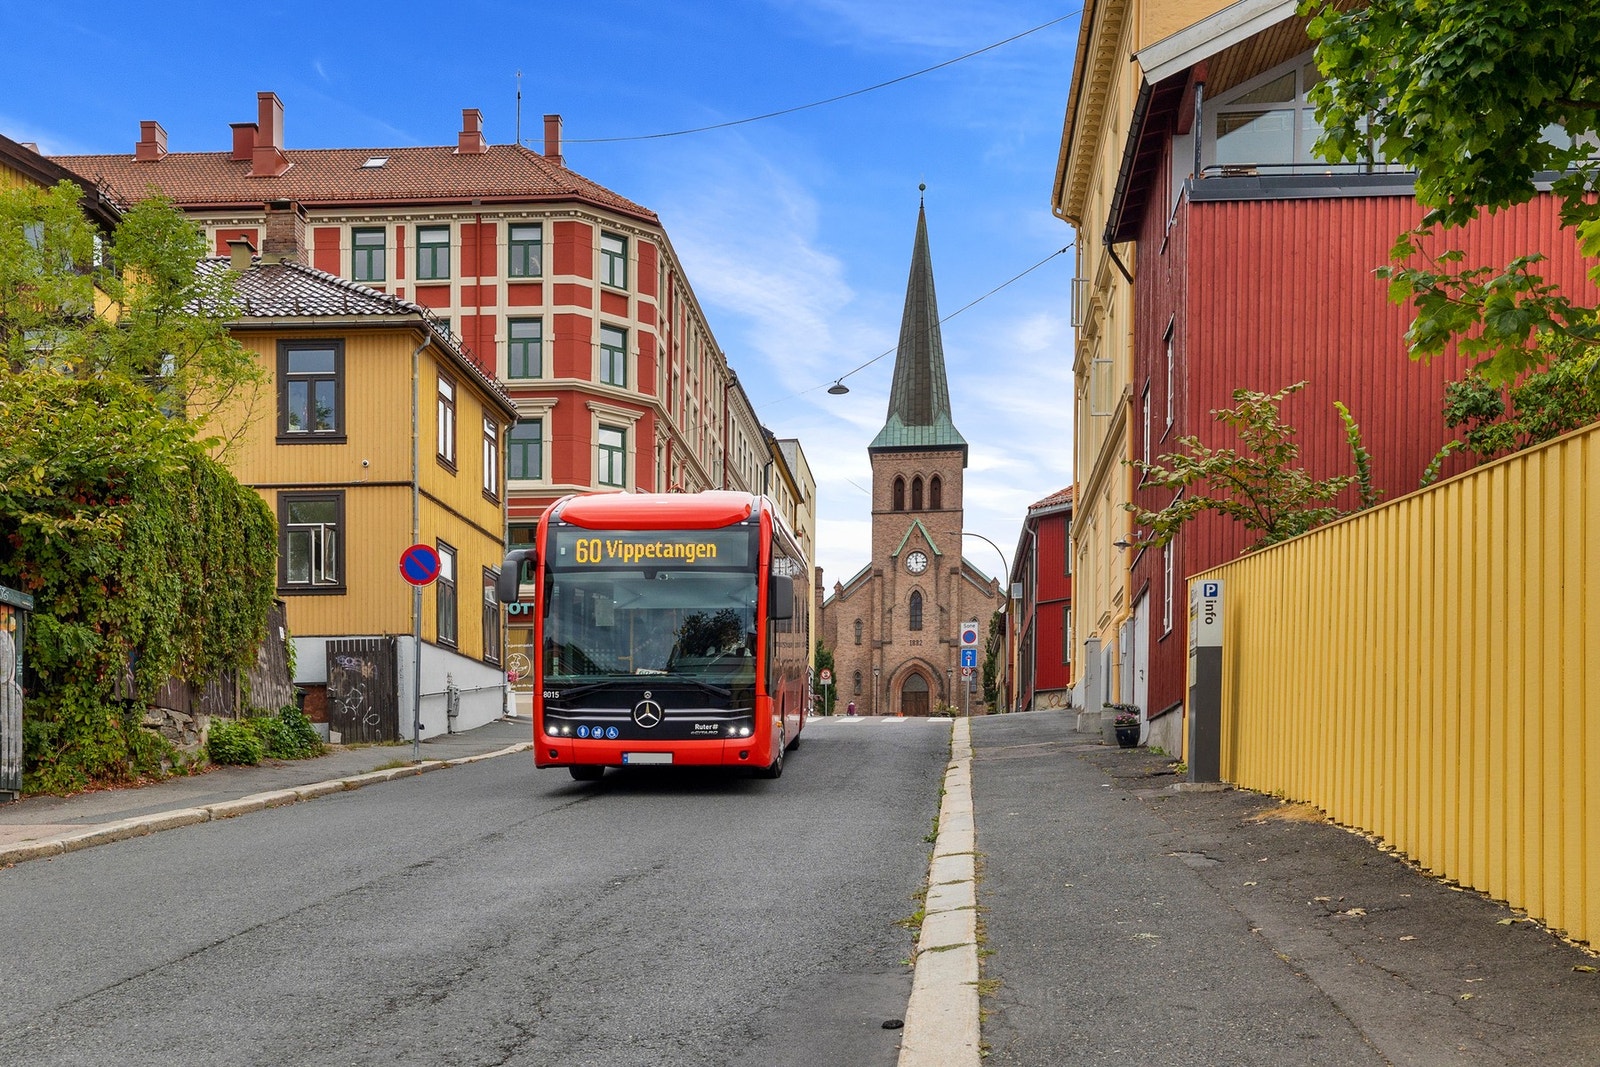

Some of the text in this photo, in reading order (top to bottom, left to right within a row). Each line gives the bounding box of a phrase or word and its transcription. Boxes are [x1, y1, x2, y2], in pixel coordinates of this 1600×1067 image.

[575, 538, 717, 563] 60 Vippetangen
[1205, 584, 1216, 597] P
[1205, 600, 1217, 625] info
[543, 690, 560, 699] 8015
